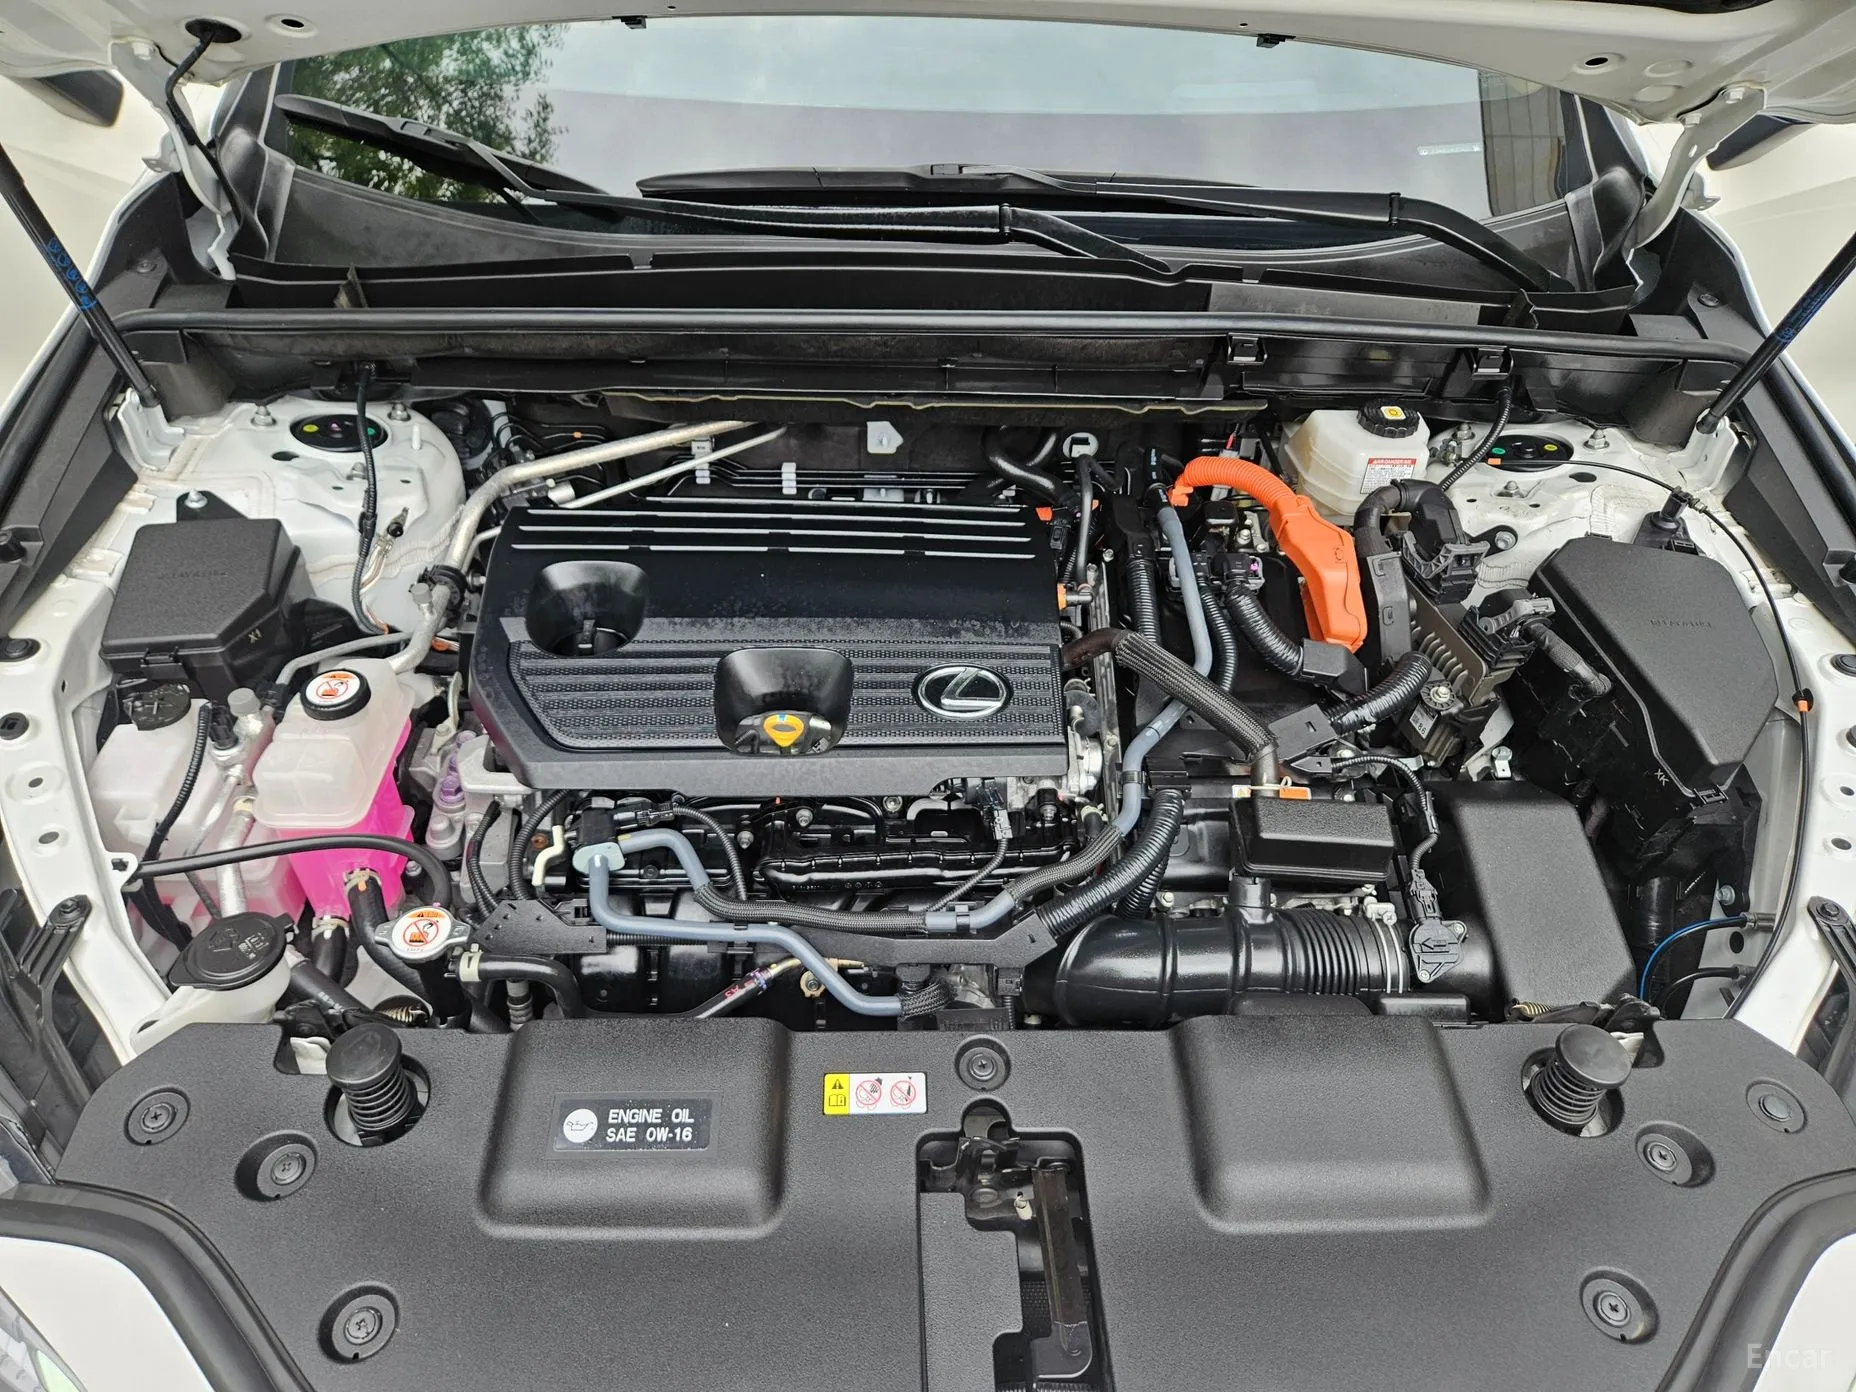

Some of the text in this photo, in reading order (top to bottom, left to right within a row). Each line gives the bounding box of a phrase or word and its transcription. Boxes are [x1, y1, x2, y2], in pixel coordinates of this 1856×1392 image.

[608, 1108, 695, 1124] ENGINE OIL
[605, 1126, 693, 1143] SAE 0W-16
